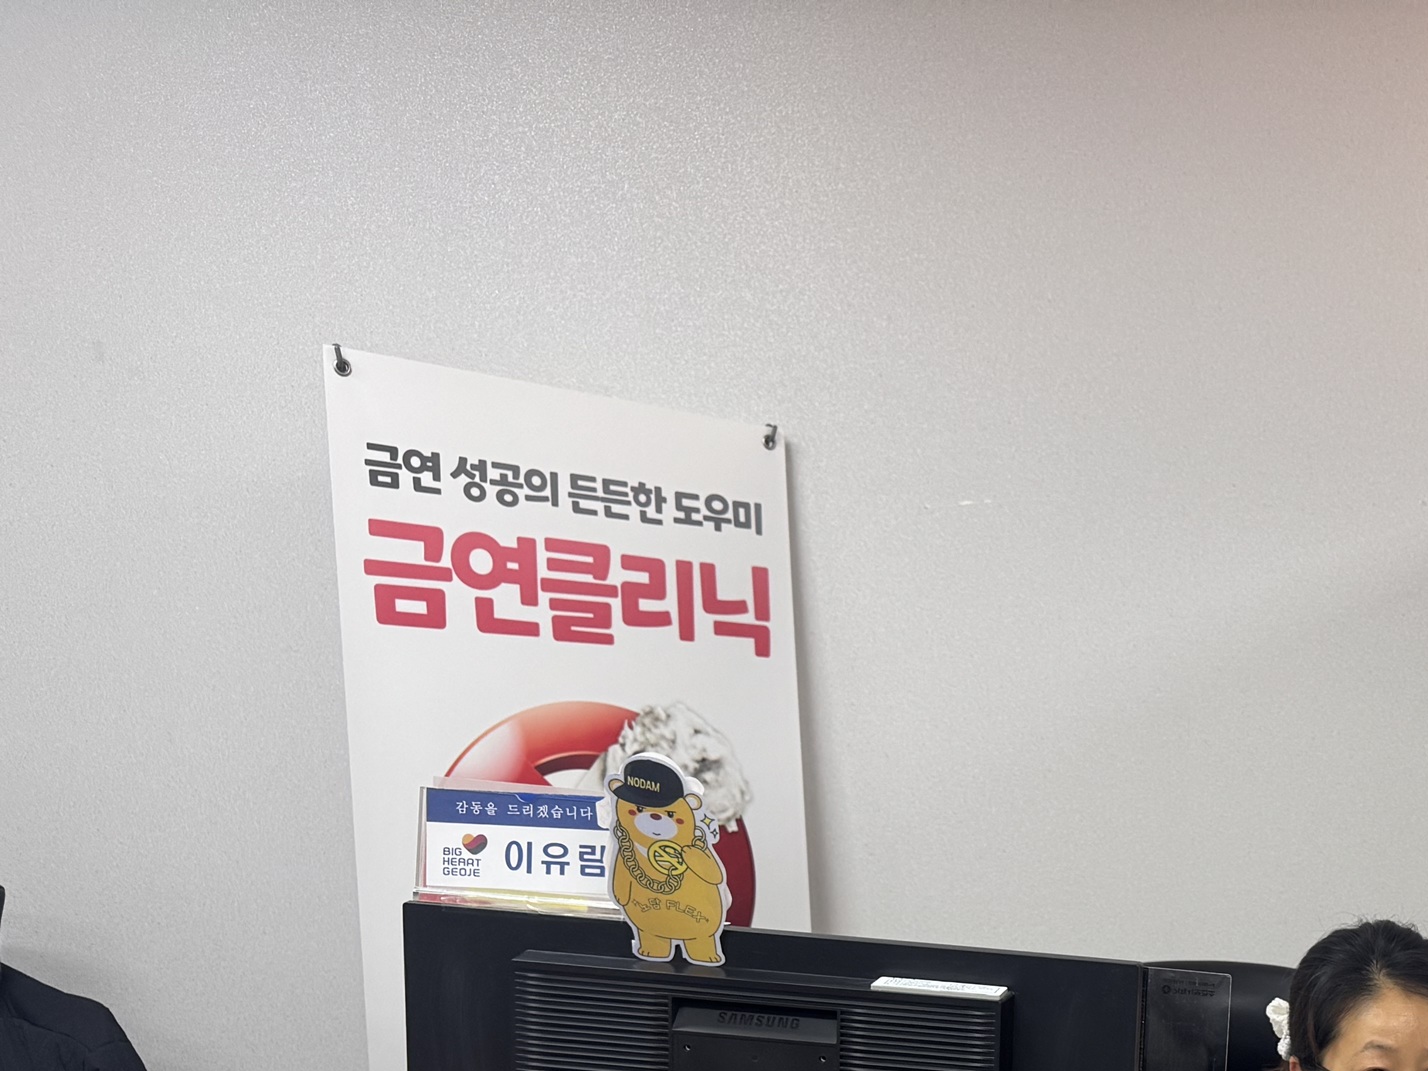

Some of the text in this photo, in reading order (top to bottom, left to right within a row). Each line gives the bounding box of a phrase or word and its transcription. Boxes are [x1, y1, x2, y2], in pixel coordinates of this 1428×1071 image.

[364, 442, 763, 535] 금연 성공의 든든한 도우미
[363, 517, 771, 659] 금연클리닉
[627, 775, 660, 793] NODAM
[455, 801, 593, 820] 감동을 드리겠습니다
[443, 847, 462, 856] BIG
[504, 840, 606, 878] 이유림
[443, 857, 481, 867] HEART
[443, 867, 481, 877] GEOJE
[717, 1010, 800, 1030] SAMSUNG
